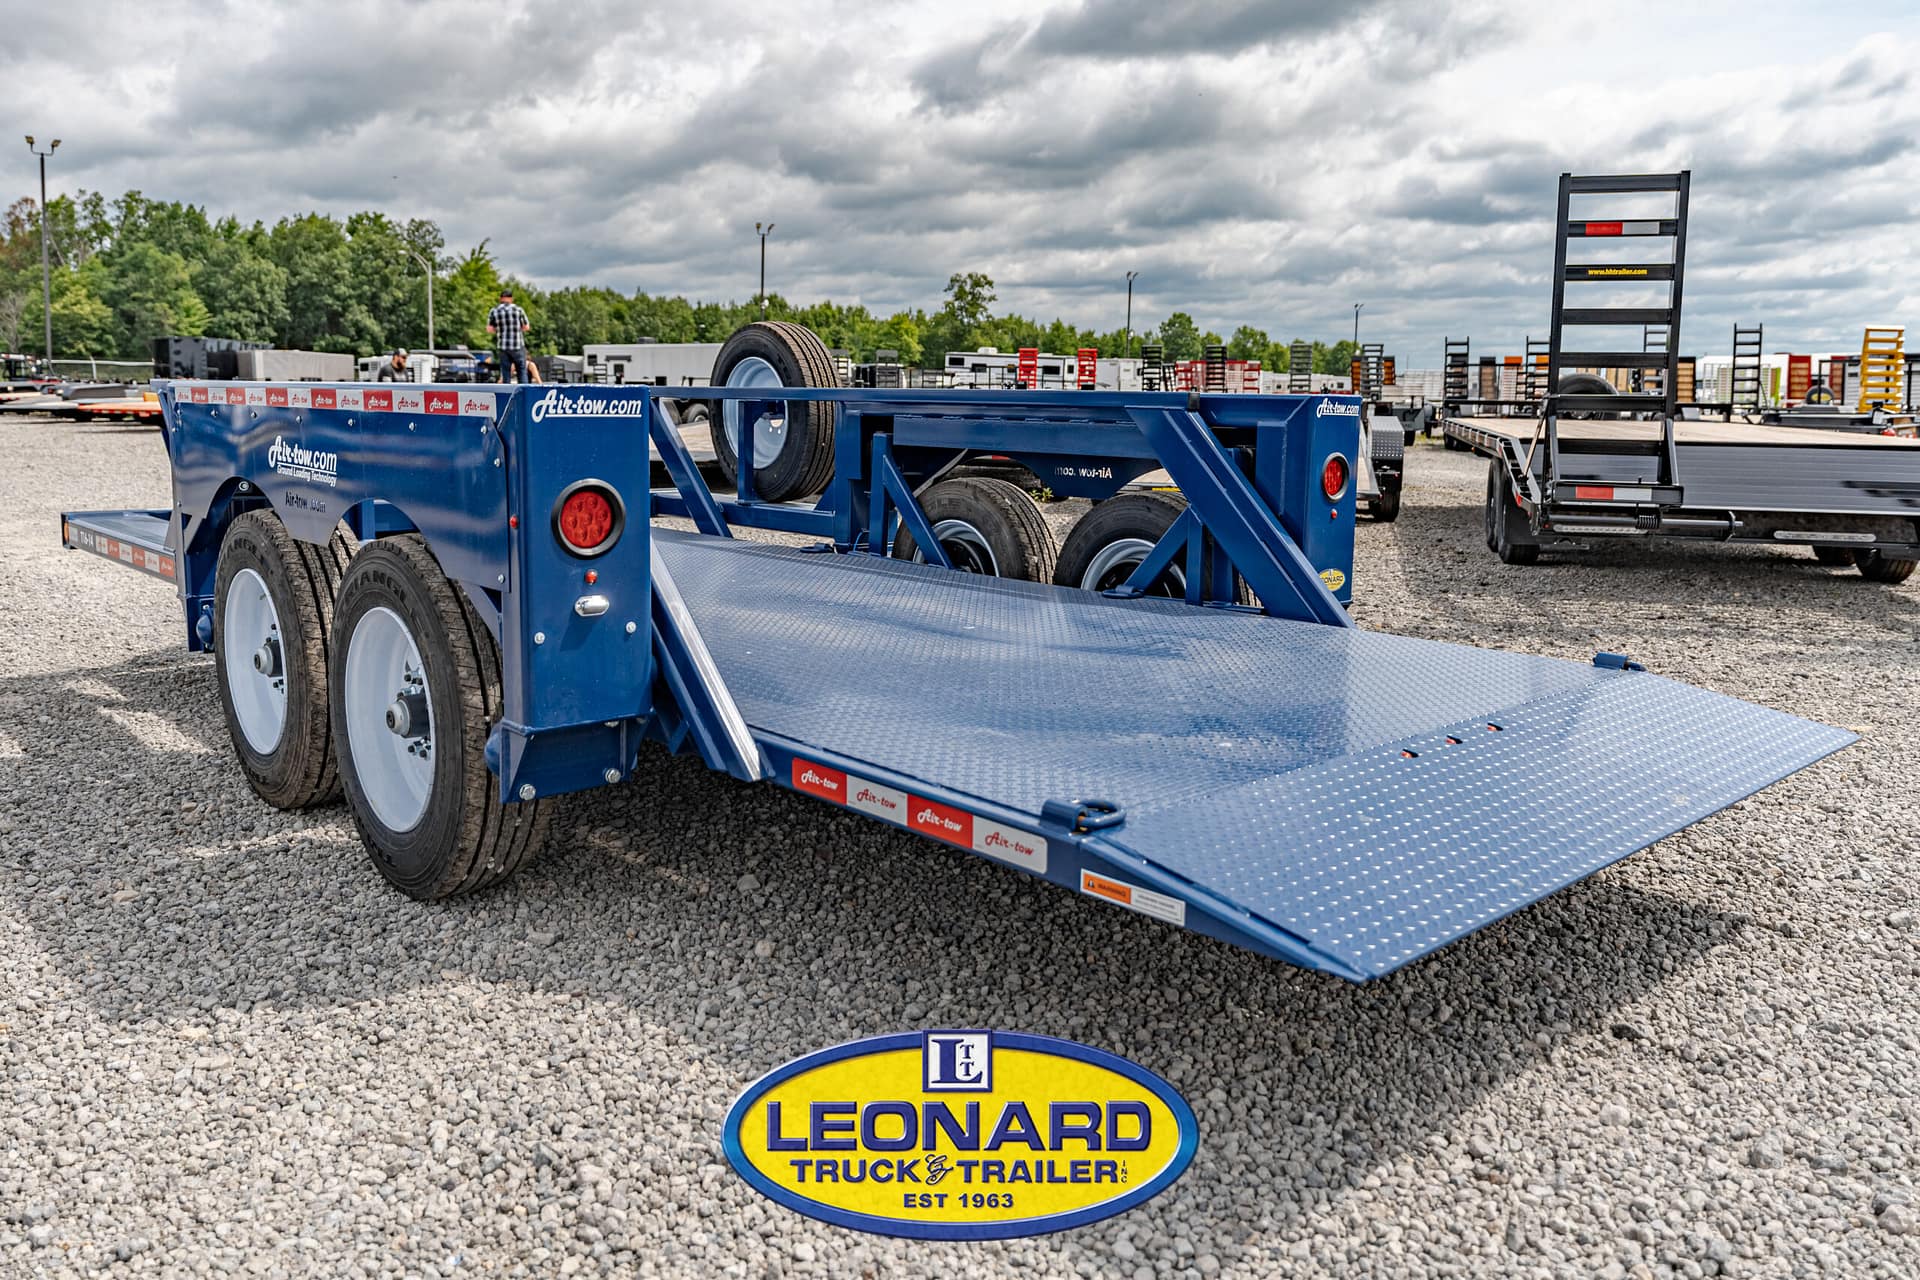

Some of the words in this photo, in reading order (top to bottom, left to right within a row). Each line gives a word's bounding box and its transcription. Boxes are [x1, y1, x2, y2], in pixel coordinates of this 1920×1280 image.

[368, 396, 389, 409] Air-tow
[398, 396, 419, 410] Air-tow
[429, 397, 454, 412] Air-tow
[464, 399, 490, 414] Air-tow
[531, 389, 642, 423] Air-tow.com
[1317, 398, 1359, 418] Air-tow.com
[268, 435, 338, 472] Air-tow.com
[277, 464, 293, 476] Ground
[293, 466, 311, 482] Loading
[311, 470, 337, 487] Technology
[801, 769, 838, 791] Air-tow
[856, 788, 897, 809] Air-tow
[917, 808, 962, 833] Air-tow
[985, 832, 1034, 857] Air-tow
